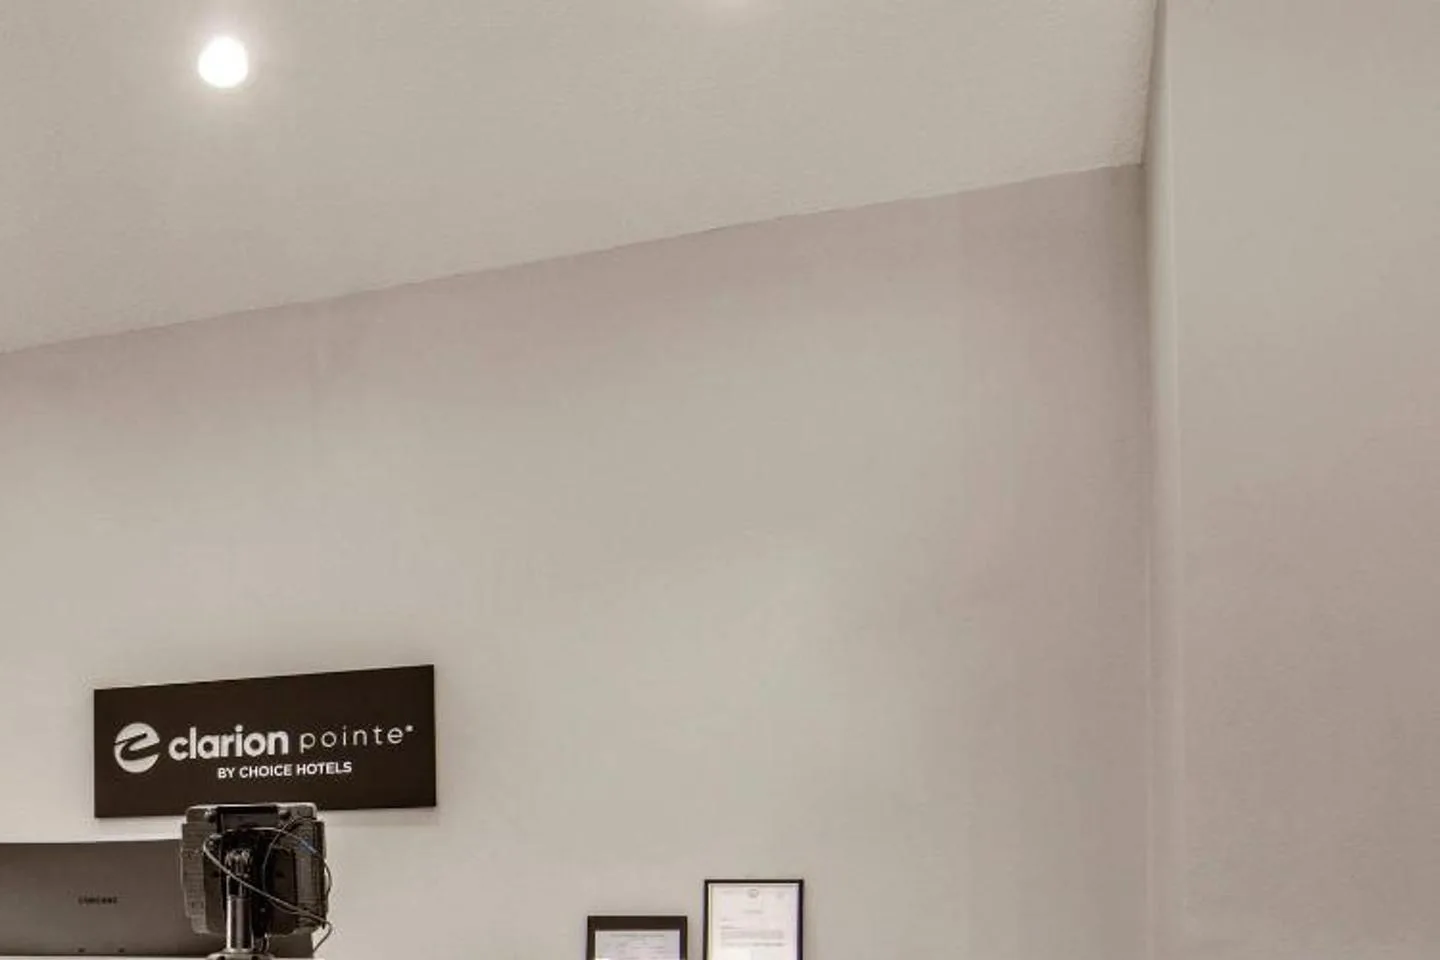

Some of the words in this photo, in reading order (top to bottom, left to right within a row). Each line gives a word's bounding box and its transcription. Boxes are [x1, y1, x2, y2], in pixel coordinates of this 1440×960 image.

[168, 724, 289, 761] clarion
[299, 725, 405, 754] pointe
[217, 767, 237, 779] BY
[239, 764, 293, 778] CHOICE
[296, 761, 353, 775] HOTELS
